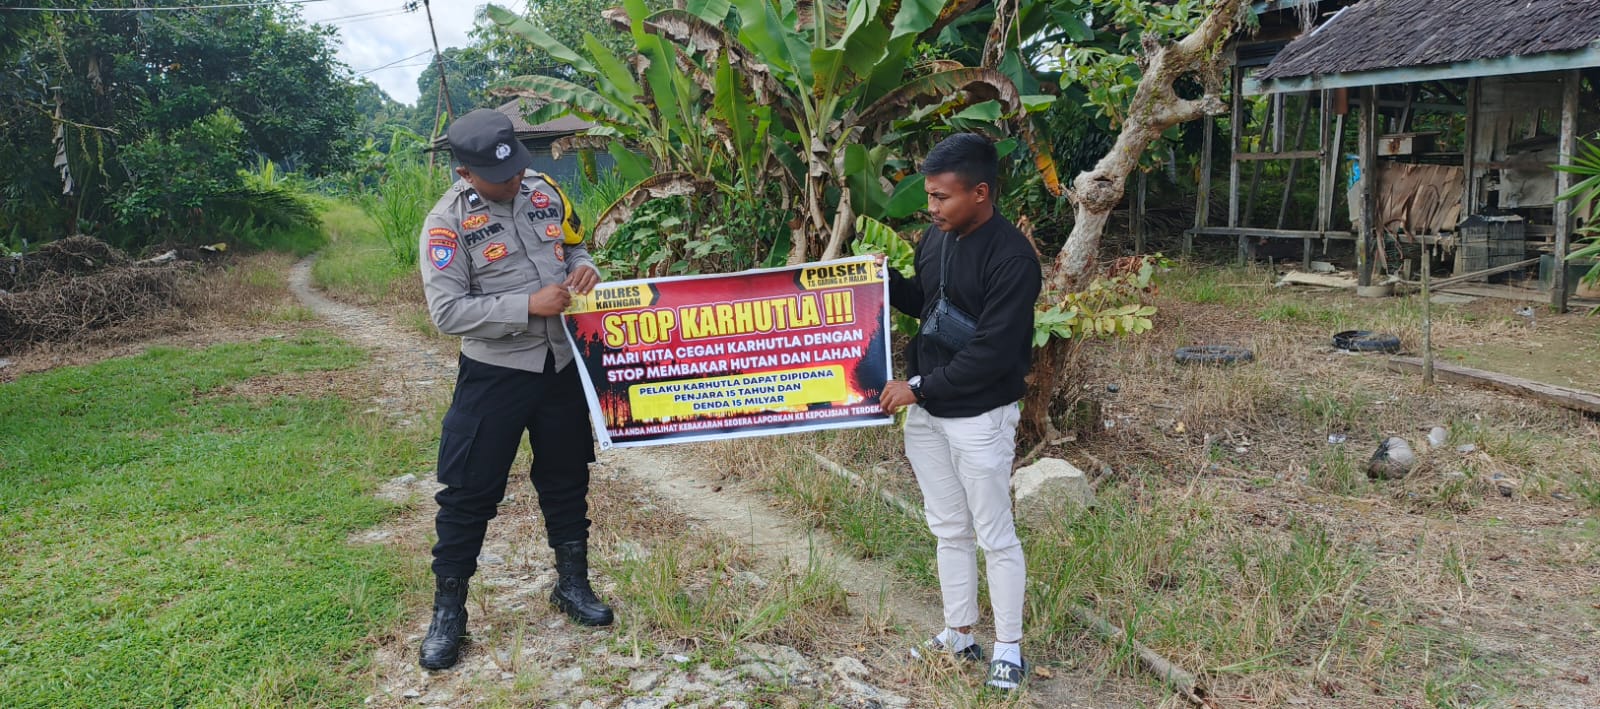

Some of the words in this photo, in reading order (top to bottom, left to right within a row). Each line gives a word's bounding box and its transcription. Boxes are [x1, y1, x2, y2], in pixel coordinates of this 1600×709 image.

[528, 208, 559, 222] POLRI
[464, 222, 505, 246] FATHIR
[806, 263, 867, 280] POLSEK
[595, 286, 640, 300] POLRES
[596, 298, 641, 310] KATINGAN
[603, 309, 676, 348] STOP
[679, 294, 822, 340] KARHUTLA
[823, 291, 853, 325] !!!
[602, 351, 639, 366] MARI
[642, 349, 674, 362] KITA
[676, 343, 725, 358] CEGAH
[728, 335, 802, 353] KARHUTLA
[803, 329, 863, 346] DENGAN
[607, 368, 644, 382] STOP
[647, 361, 727, 378] MEMBAKAR
[731, 355, 778, 369] HUTAN
[781, 351, 811, 365] DAN
[814, 346, 862, 362] LAHAN
[640, 384, 681, 395] PELAKU
[683, 378, 741, 390] KARHUTLA
[743, 375, 778, 385] DAPAT
[780, 369, 834, 381] DIPIDANA
[674, 390, 724, 402] PENJARA
[726, 389, 736, 398] 15
[739, 383, 775, 395] TAHUN
[777, 382, 801, 392] DAN
[693, 400, 730, 410] DENDA
[732, 398, 742, 407] 15
[744, 395, 785, 406] MILYAR
[625, 426, 646, 436] ANDA
[646, 423, 679, 434] MELIHAT
[680, 420, 723, 432] KEBAKARAN
[724, 416, 753, 428] SEGERA
[753, 413, 794, 424] LAPORKAN
[795, 411, 805, 420] KE
[805, 408, 849, 420] KEPOLISIAN
